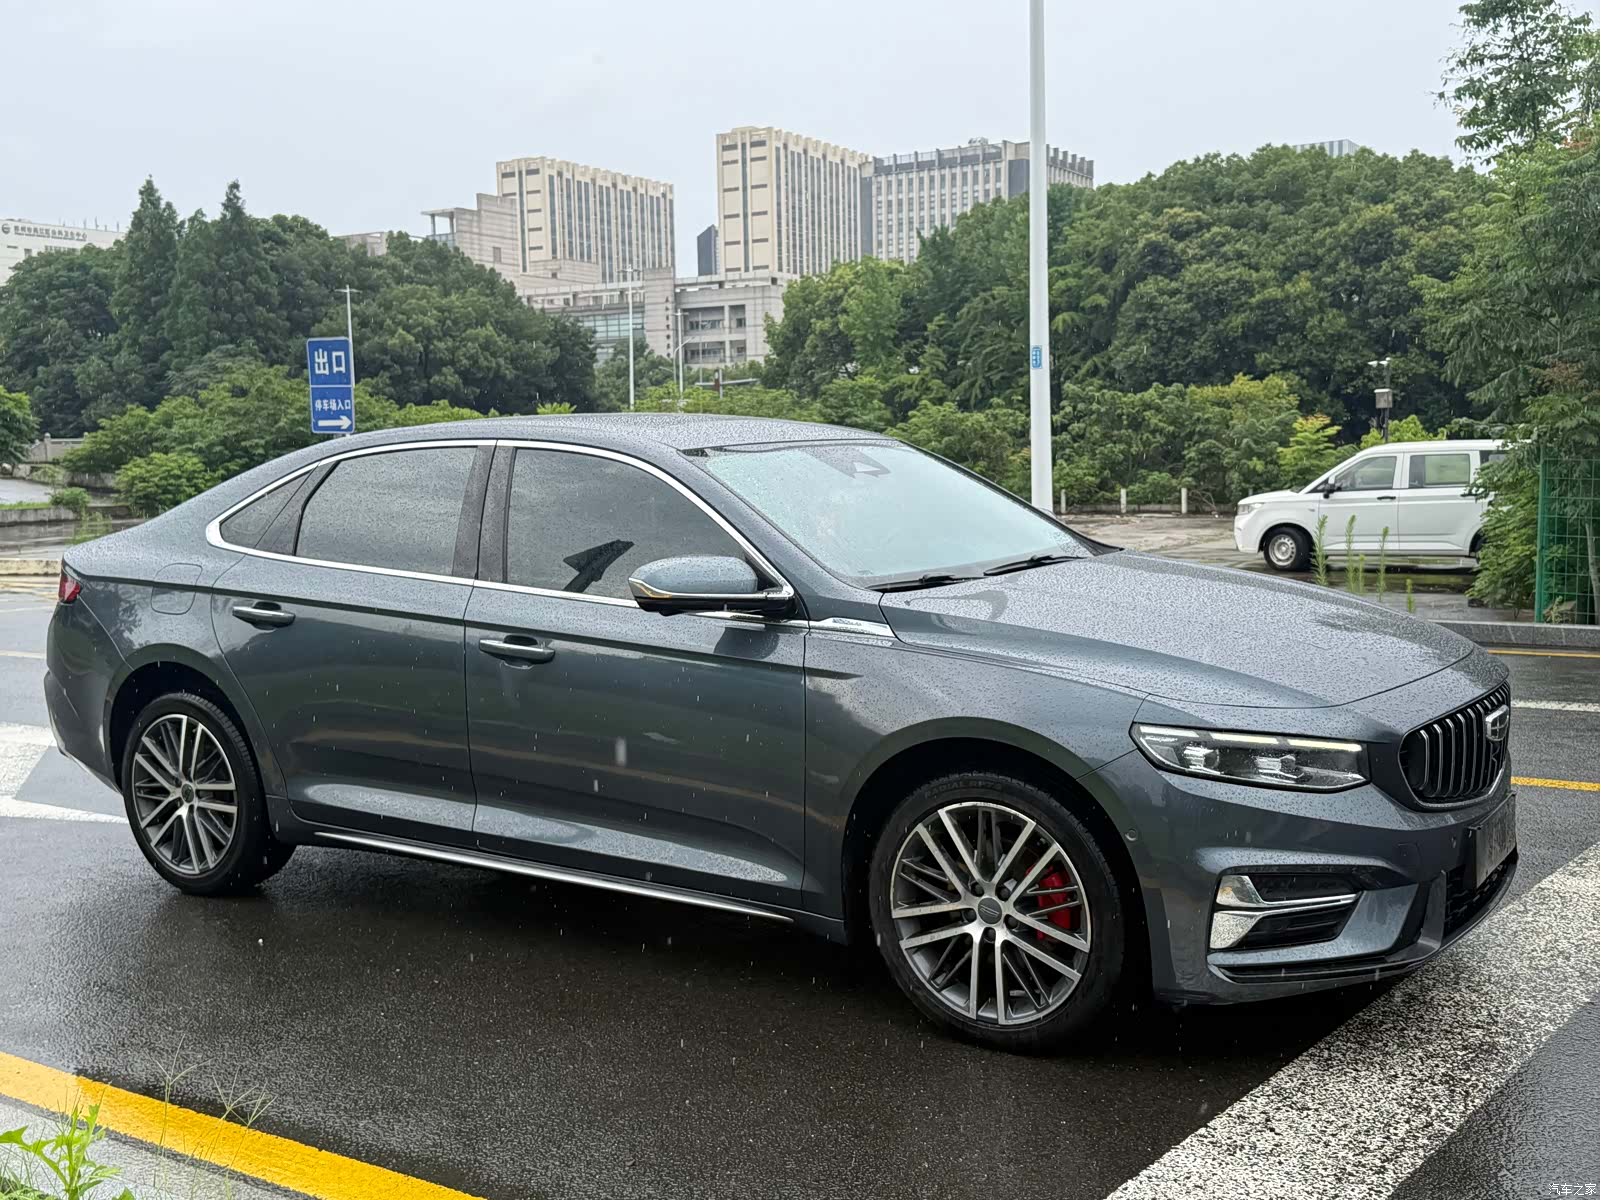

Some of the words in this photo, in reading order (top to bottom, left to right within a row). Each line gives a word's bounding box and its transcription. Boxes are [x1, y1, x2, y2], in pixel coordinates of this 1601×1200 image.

[314, 348, 346, 375] 出口
[315, 399, 351, 412] 停车场入口
